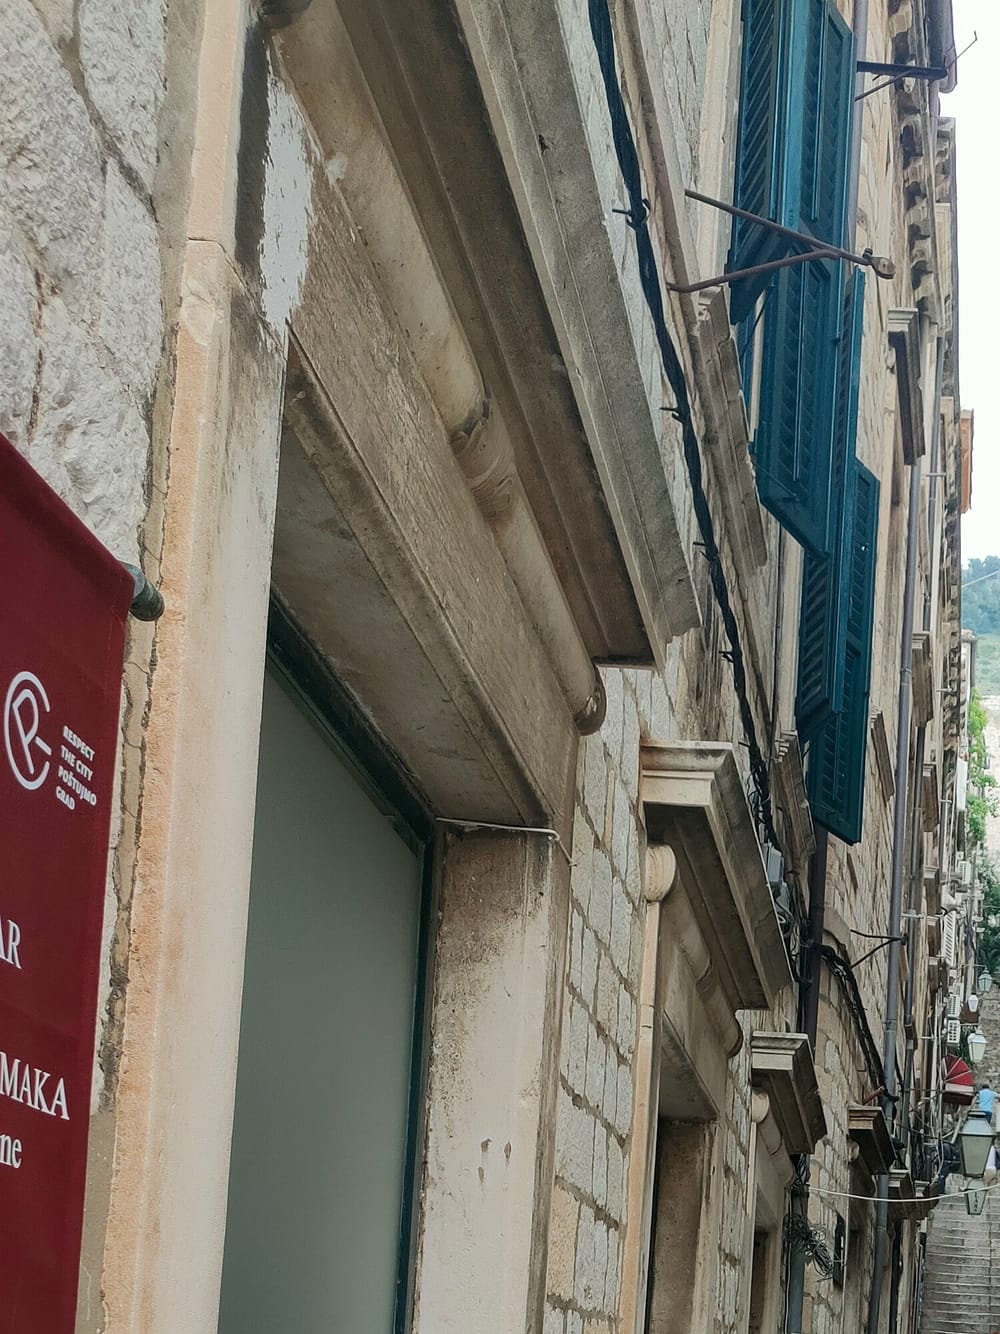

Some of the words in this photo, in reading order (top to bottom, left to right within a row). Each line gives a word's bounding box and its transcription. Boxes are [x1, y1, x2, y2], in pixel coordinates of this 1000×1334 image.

[62, 725, 95, 761] RESPECT
[60, 744, 76, 768] THE
[75, 759, 93, 781] CITY
[55, 785, 76, 810] GRAD
[58, 764, 97, 806] POŠTUJMO
